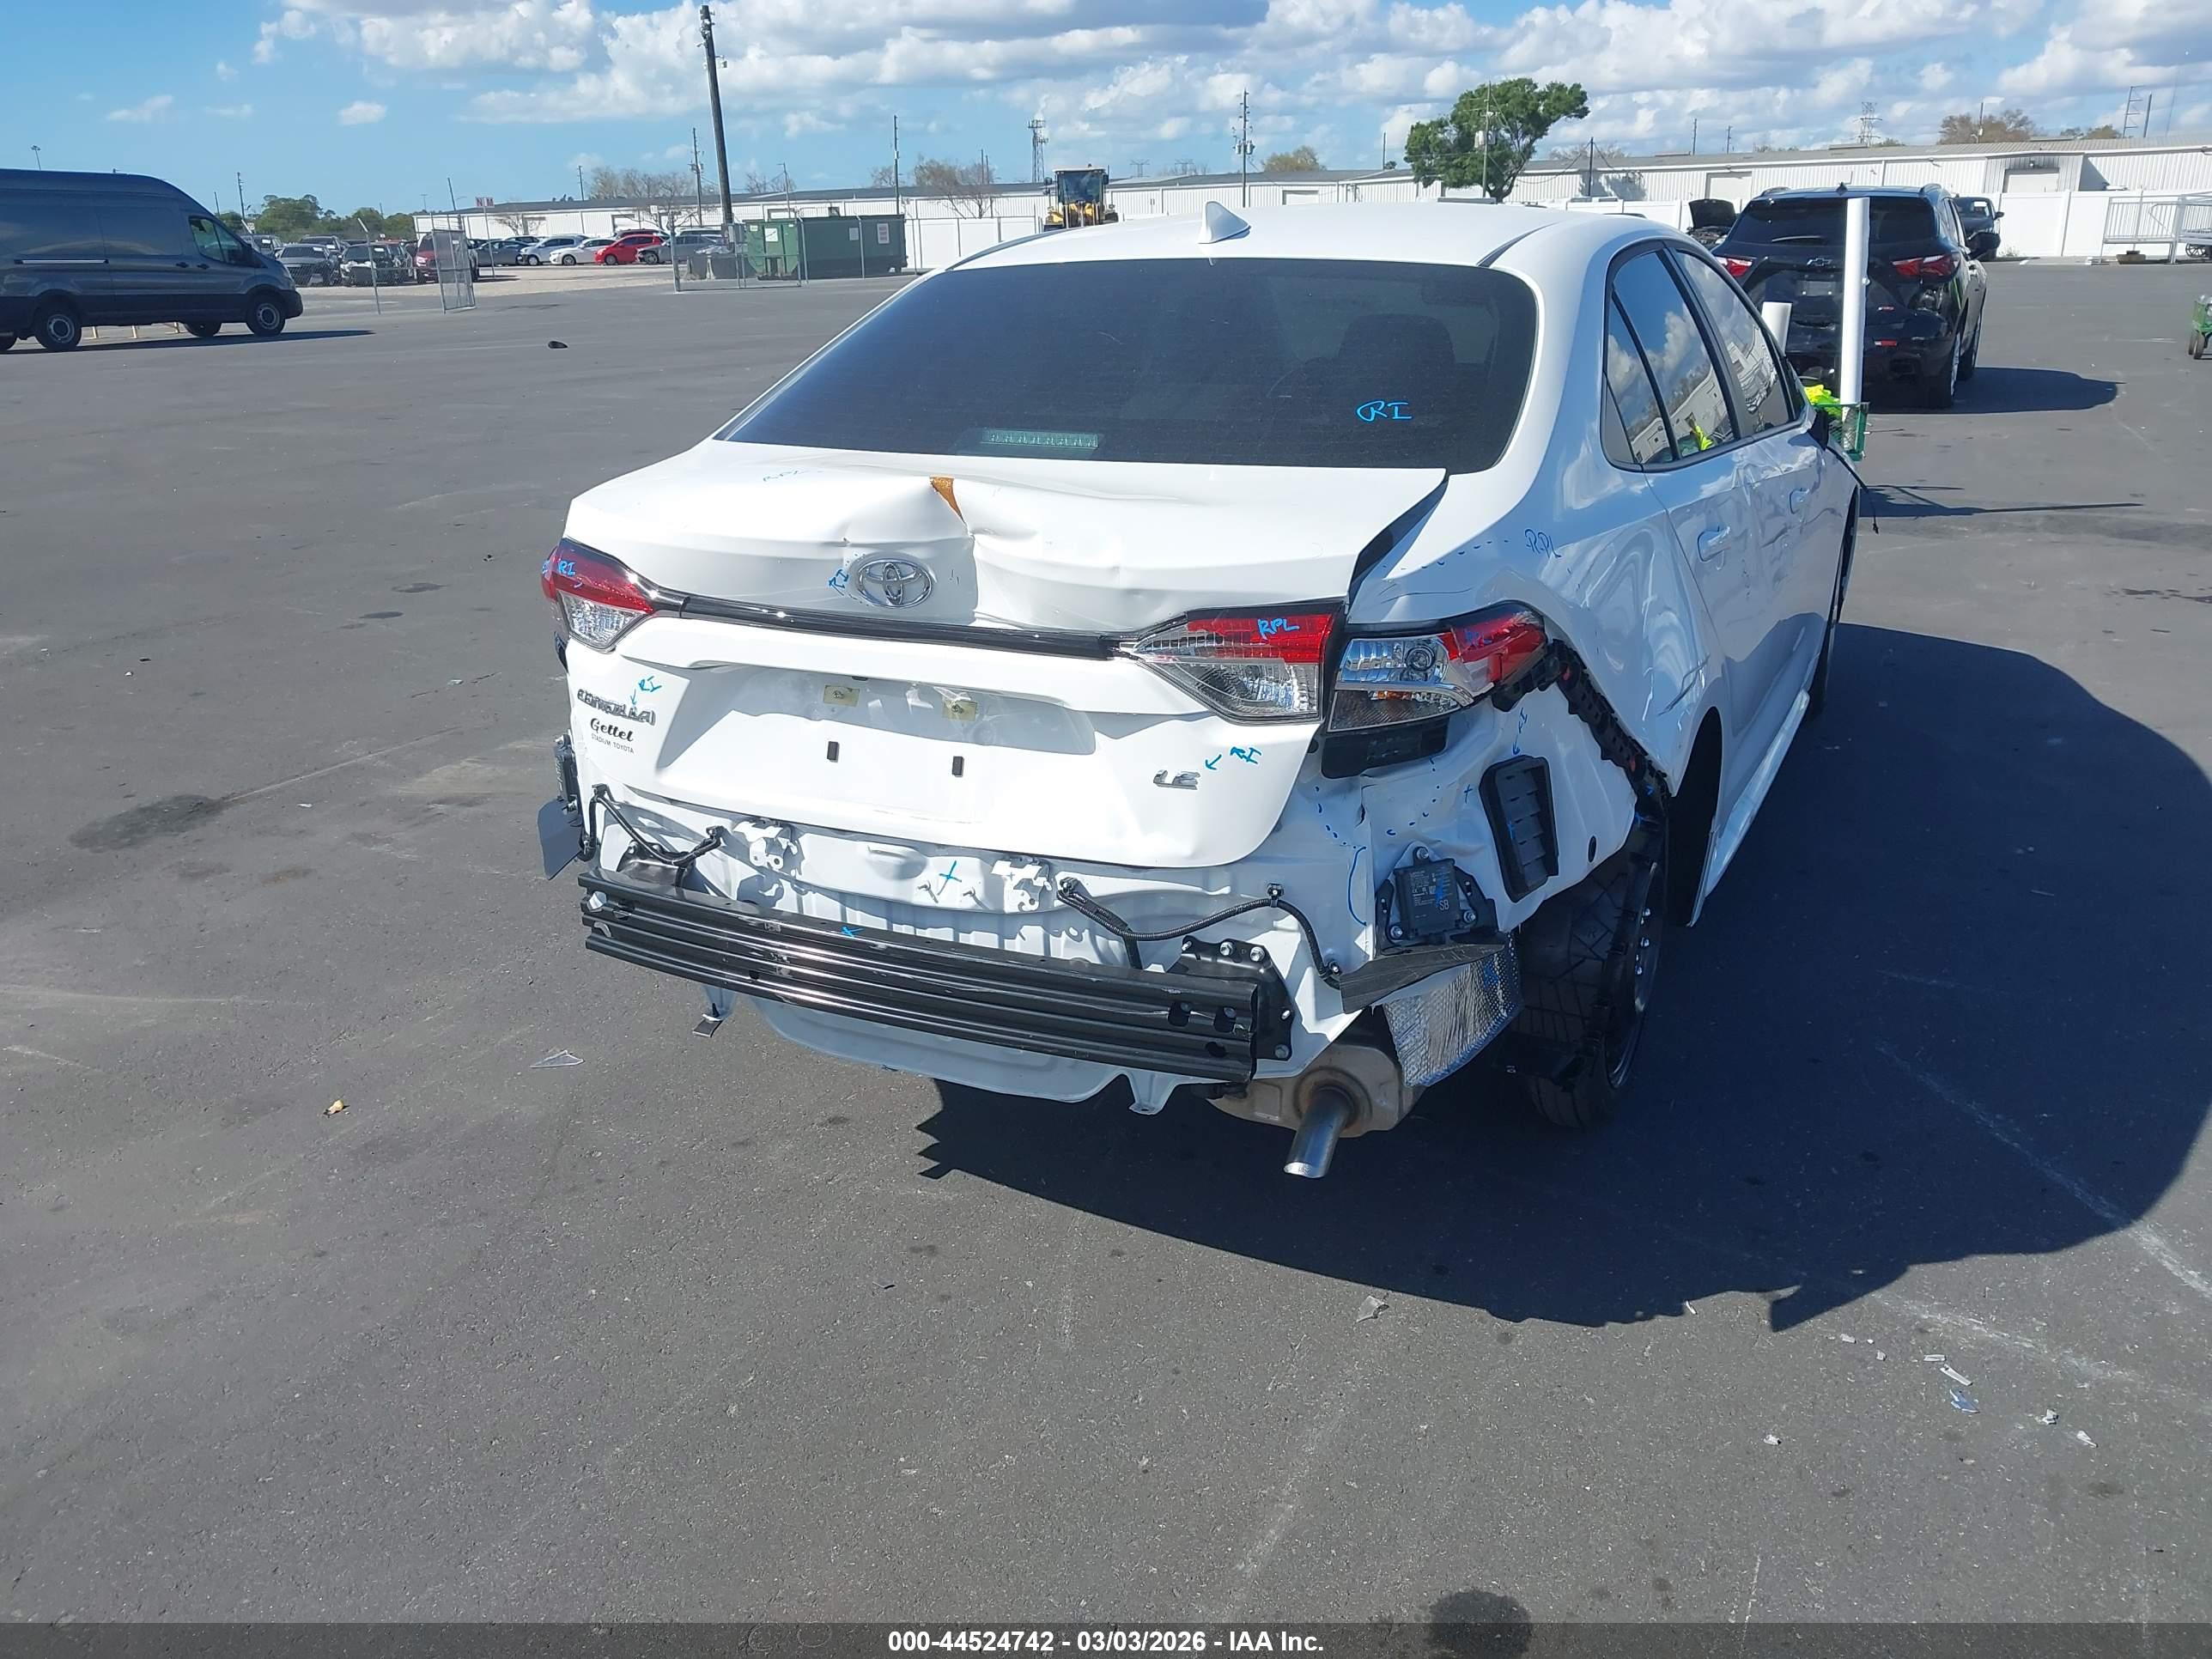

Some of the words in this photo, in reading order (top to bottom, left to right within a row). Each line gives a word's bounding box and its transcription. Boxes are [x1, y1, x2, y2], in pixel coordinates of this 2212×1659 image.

[1357, 400, 1413, 422] RI
[1257, 618, 1299, 641] RPL
[590, 717, 635, 742] Gettel
[612, 741, 635, 755] TOYOTA
